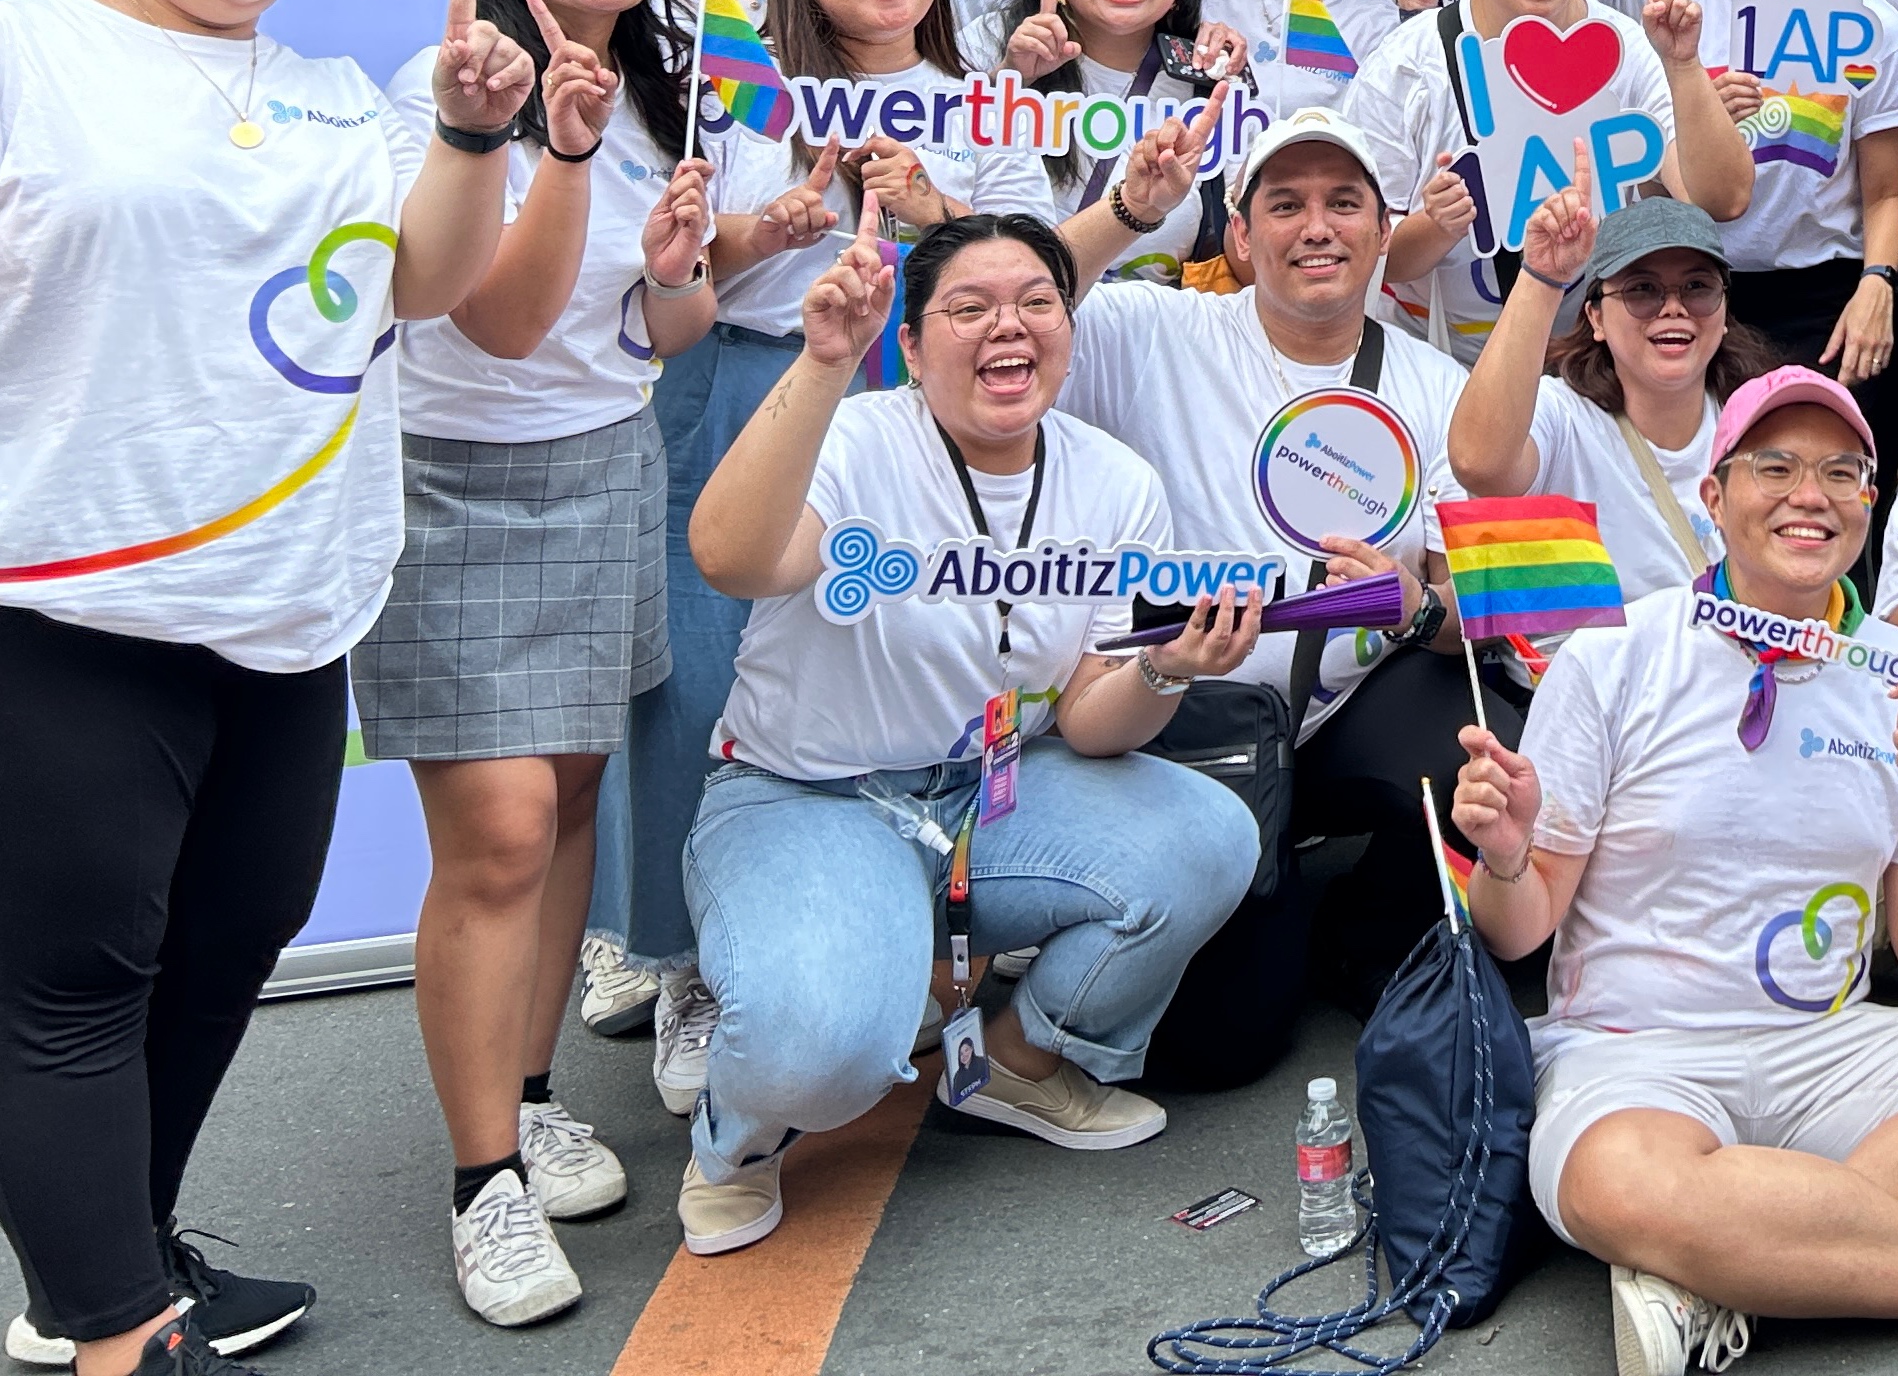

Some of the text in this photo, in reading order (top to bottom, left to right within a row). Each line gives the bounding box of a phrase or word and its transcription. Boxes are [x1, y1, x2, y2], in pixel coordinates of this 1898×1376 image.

[1735, 5, 1875, 84] 1AP
[1275, 445, 1389, 519] powerthrough
[1319, 444, 1376, 483] AboitizPower
[927, 545, 1279, 598] AboitizPower
